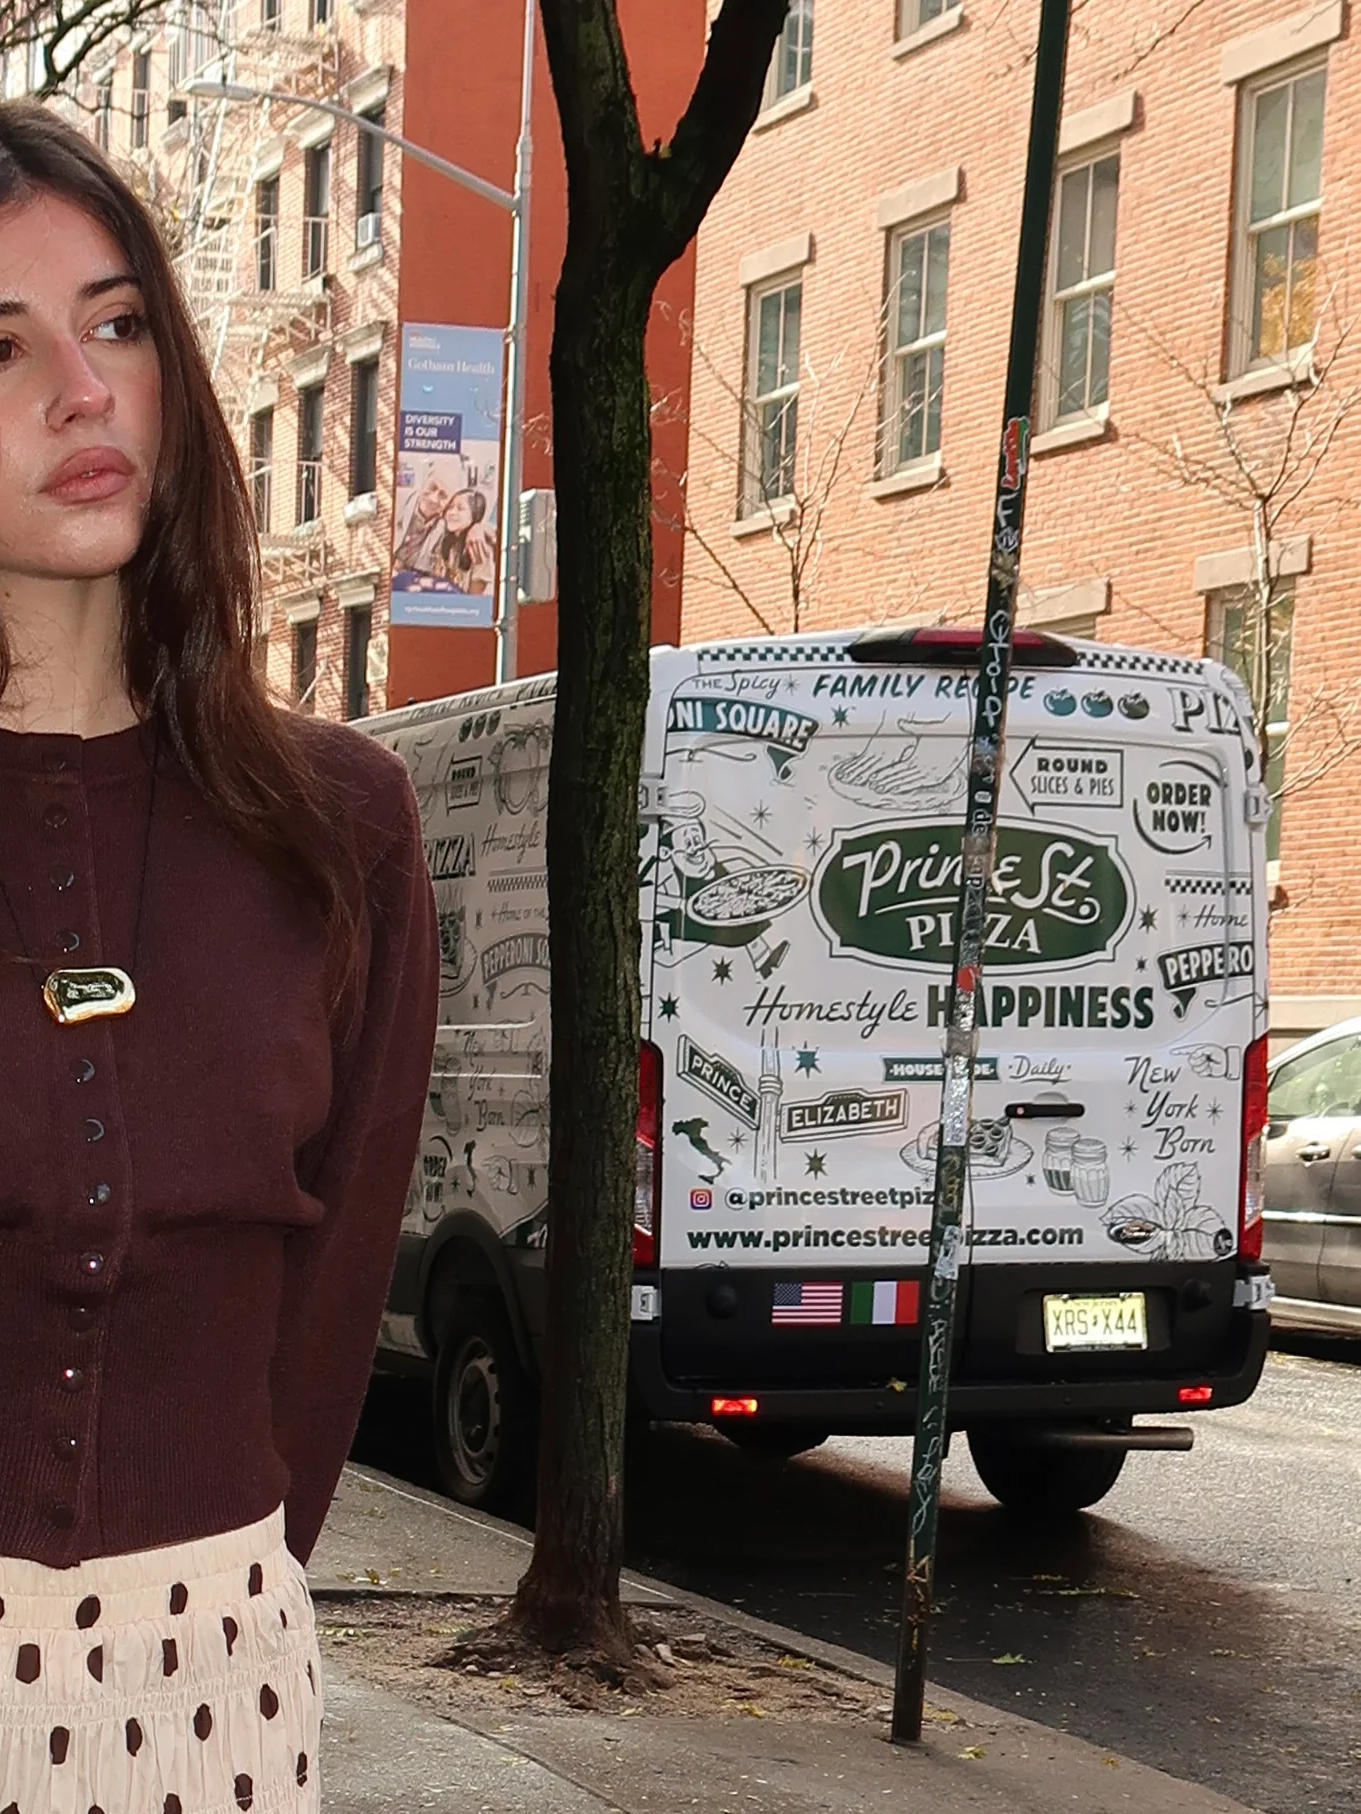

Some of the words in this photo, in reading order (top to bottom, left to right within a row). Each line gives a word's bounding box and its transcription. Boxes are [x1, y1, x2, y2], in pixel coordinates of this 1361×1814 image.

[404, 426, 414, 437] IS
[415, 427, 438, 437] OUR
[405, 413, 455, 426] DIVERSITY
[404, 438, 457, 450] STRENGTH
[692, 678, 723, 690] THE
[724, 671, 781, 699] Spicy
[813, 674, 925, 699] FAMILY
[716, 702, 814, 748] SQUARE
[1037, 757, 1108, 774] ROUND
[1031, 775, 1069, 794] SLICES
[1074, 778, 1084, 795] &
[1090, 778, 1114, 796] PIES
[1146, 782, 1212, 807] ORDER
[1152, 811, 1206, 833] NOW!
[843, 840, 1022, 917] Prine
[1194, 904, 1249, 928] Home
[906, 912, 1042, 954] PIZA
[1165, 944, 1253, 985] PEPPERO
[743, 985, 918, 1039] Homestyle
[691, 1054, 753, 1113] PRINCE
[893, 1063, 943, 1077] HOUSE
[1009, 1055, 1067, 1085] Daily
[1124, 1056, 1182, 1093] New
[791, 1098, 899, 1128] ELIZABETH
[1141, 1090, 1199, 1128] York
[1154, 1126, 1216, 1160] Born
[688, 1224, 1084, 1252] www.princestreeizza.com
[1053, 1309, 1088, 1336] XRS
[1102, 1308, 1137, 1335] X44
